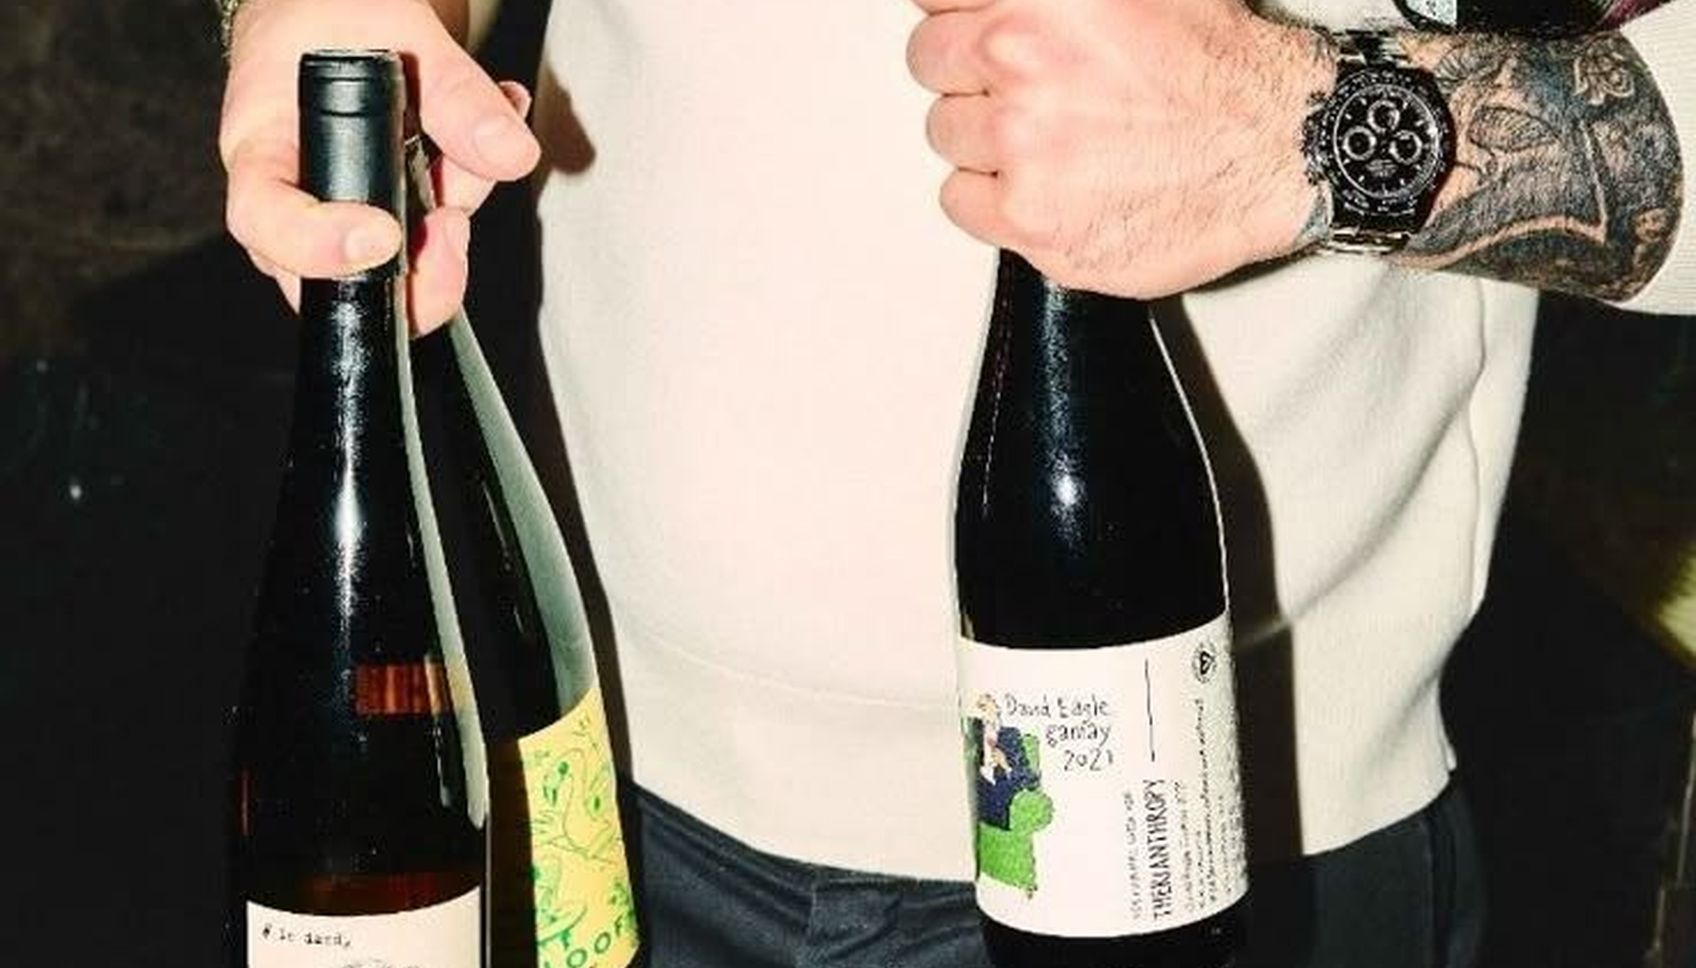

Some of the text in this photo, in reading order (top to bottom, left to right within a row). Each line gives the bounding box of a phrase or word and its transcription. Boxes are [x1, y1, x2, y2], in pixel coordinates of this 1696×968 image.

[1005, 693, 1109, 724] David Eagle
[1046, 722, 1112, 748] gamay
[1063, 748, 1114, 771] 2021
